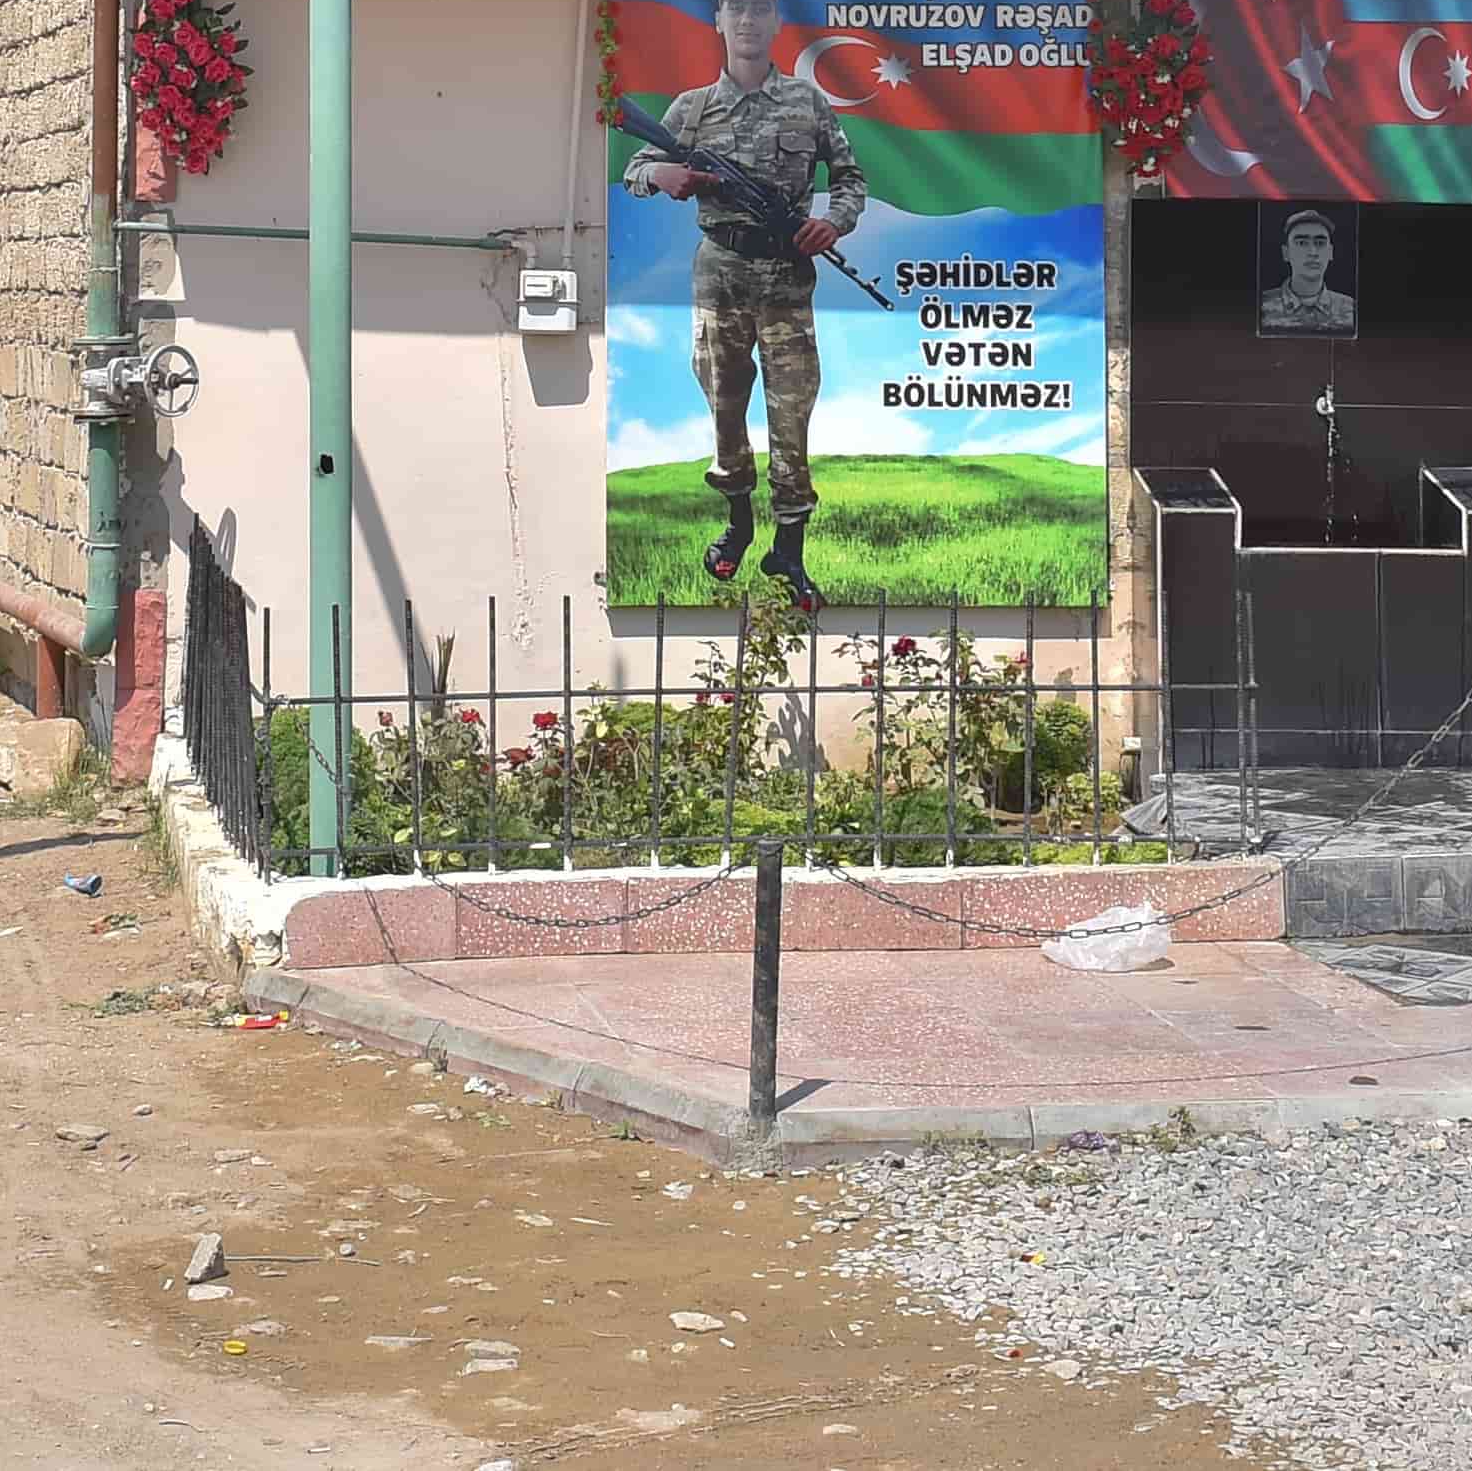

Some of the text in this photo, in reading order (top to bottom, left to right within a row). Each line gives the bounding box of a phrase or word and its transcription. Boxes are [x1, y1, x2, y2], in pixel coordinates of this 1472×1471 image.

[828, 4, 1094, 34] NOVRUZOV RƏŞAD
[922, 43, 1014, 73] ELŞAD
[896, 255, 1056, 295] ŞƏHİDLƏR
[920, 296, 1033, 329] ÖLMƏZ
[922, 342, 1032, 366] VƏTƏN
[883, 375, 1071, 408] BÖLÜNMƏZ!
